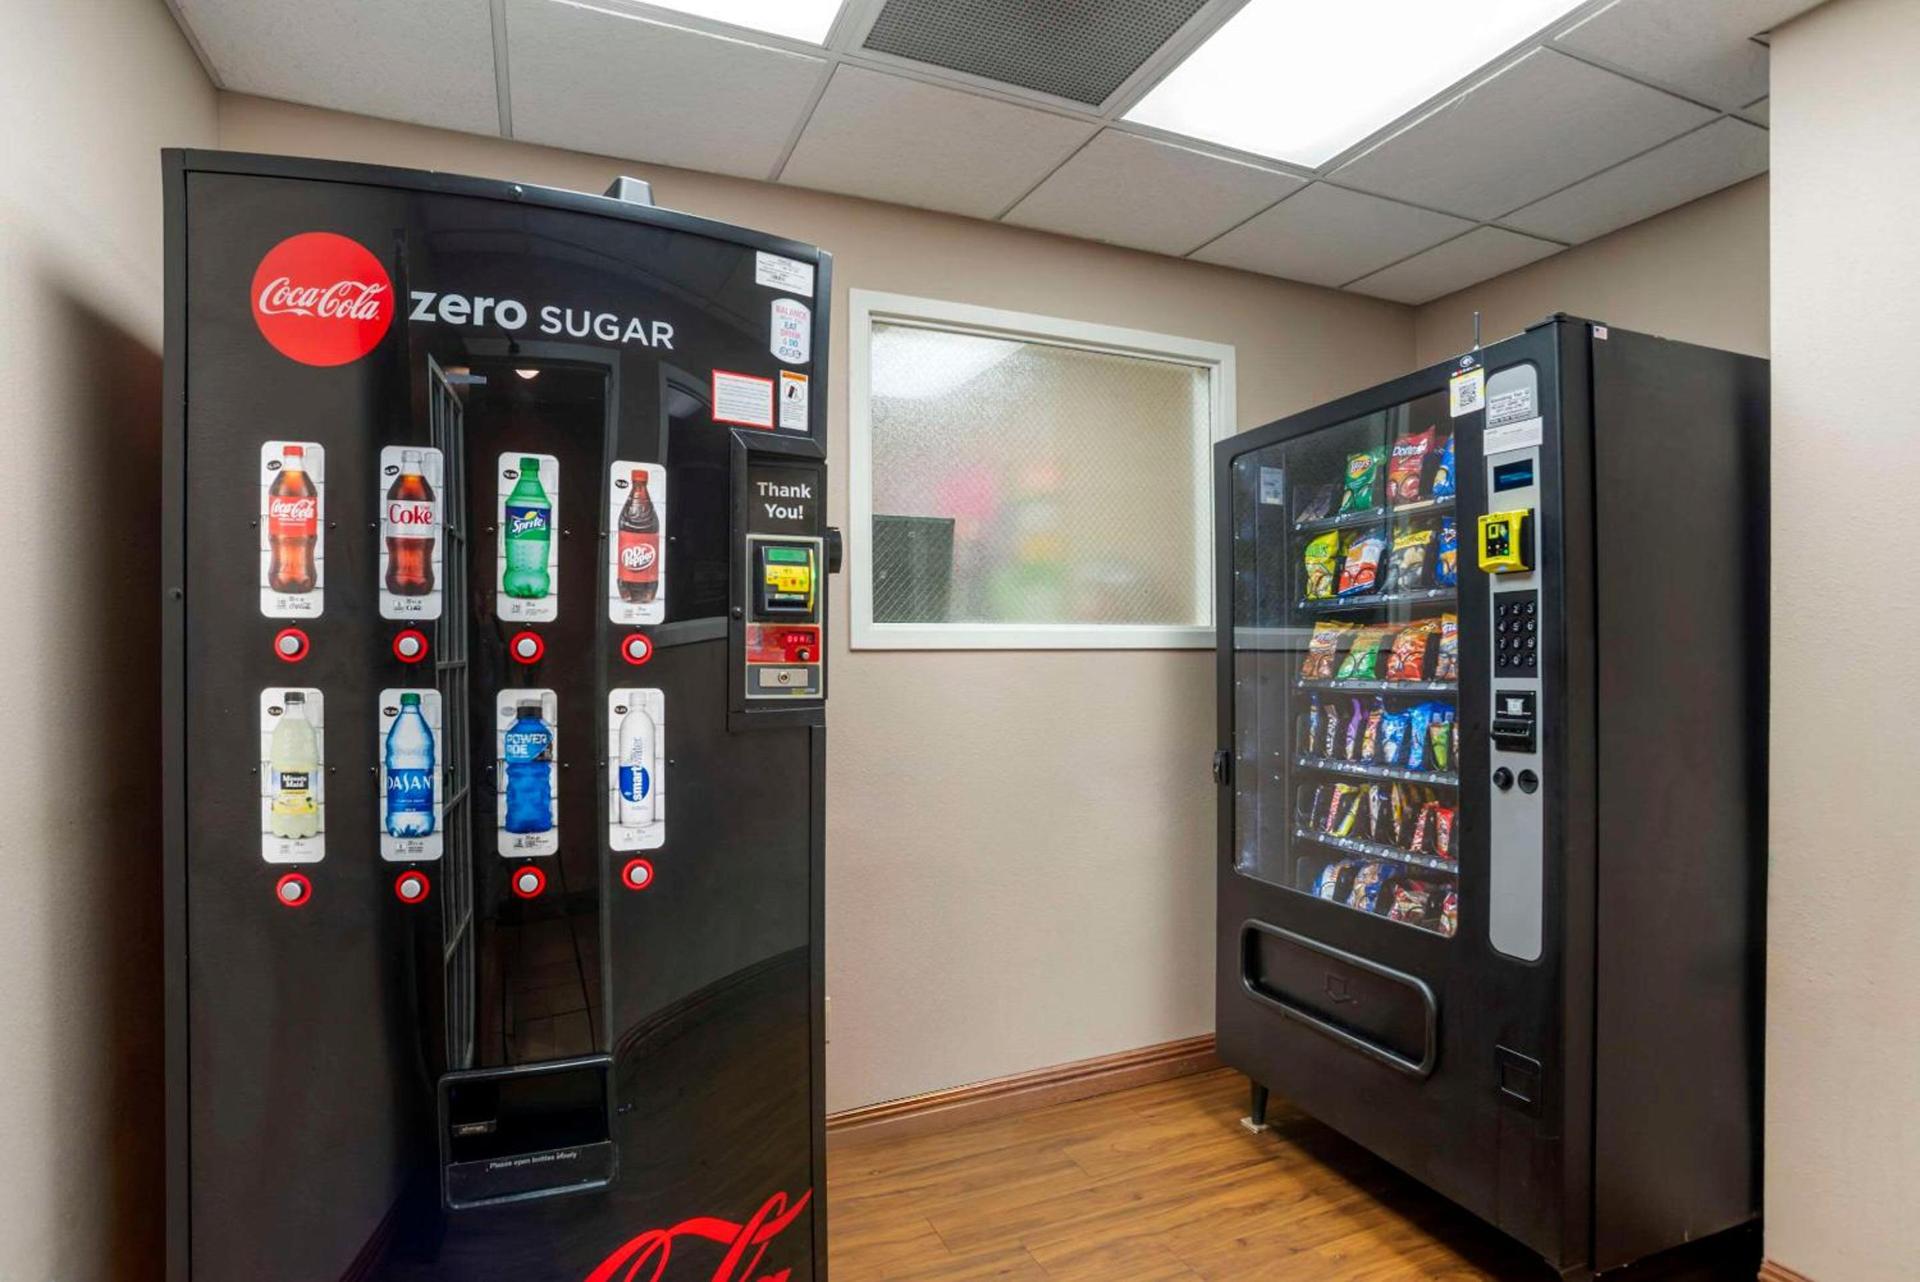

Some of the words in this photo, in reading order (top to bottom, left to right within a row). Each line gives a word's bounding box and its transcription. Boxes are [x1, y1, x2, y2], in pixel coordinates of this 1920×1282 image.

[259, 277, 388, 321] Coca-Cola
[408, 291, 527, 330] zero
[540, 306, 675, 350] SUGAR
[756, 481, 811, 499] Thank
[271, 499, 315, 520] Coca-Cola
[390, 504, 432, 525] Coke
[765, 503, 804, 519] You!
[512, 516, 544, 533] Sprite
[507, 733, 547, 745] POWER
[631, 764, 643, 802] smart
